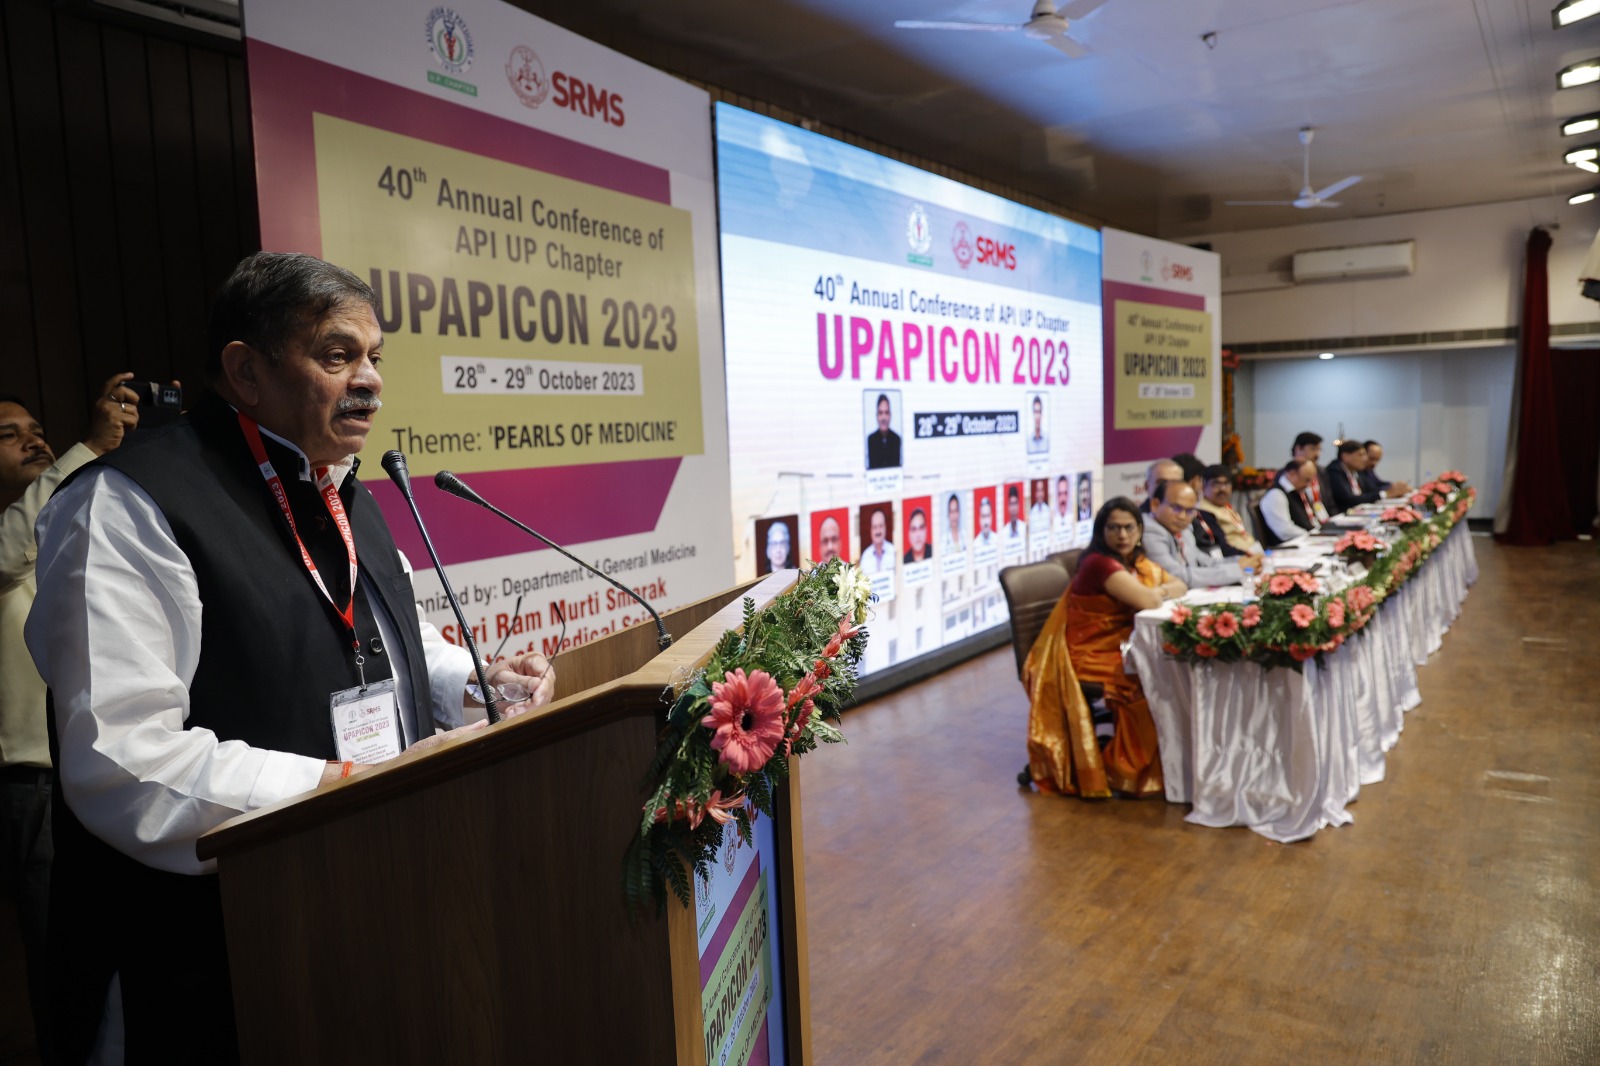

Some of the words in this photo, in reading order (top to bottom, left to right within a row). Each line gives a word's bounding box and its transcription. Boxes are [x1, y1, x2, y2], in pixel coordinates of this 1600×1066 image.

[552, 70, 625, 128] SRMS
[378, 165, 427, 200] 40th
[437, 178, 522, 222] Annual
[532, 200, 643, 247] Conference
[648, 228, 664, 251] of
[455, 225, 497, 259] API
[505, 234, 537, 264] UP
[546, 242, 623, 280] Chapter
[976, 235, 1016, 271] SRMS
[370, 268, 589, 345] UPAPICON
[602, 298, 677, 352] 2023
[814, 274, 844, 302] 40th
[851, 281, 904, 310] Annual
[909, 289, 980, 322] Conference
[985, 303, 995, 323] of
[999, 304, 1016, 325] API
[1019, 307, 1033, 327] UP
[1037, 311, 1070, 333] Chapter
[816, 311, 1001, 384] UPAPICON
[1012, 335, 1070, 386] 2023
[1124, 352, 1180, 377] UPAPICON
[1182, 357, 1206, 378] 2023
[455, 362, 486, 389] 28th
[505, 364, 533, 390] 29th
[539, 369, 597, 391] October
[602, 371, 635, 391] 2023
[392, 427, 481, 455] Theme:
[489, 424, 565, 450] 'PEARLS
[571, 423, 593, 446] OF
[599, 421, 677, 444] MEDICINE'
[962, 415, 996, 435] October
[326, 488, 343, 512] 2023
[474, 584, 497, 605] by:
[503, 567, 583, 597] Department
[603, 551, 647, 575] General
[651, 544, 696, 565] Medicine
[496, 606, 542, 640] Ram
[550, 591, 599, 626] Murti
[606, 577, 667, 611] Smarak
[343, 724, 374, 741] UPAPICON
[375, 720, 390, 731] 2023
[367, 705, 381, 716] SRMS
[749, 909, 766, 970] 2023
